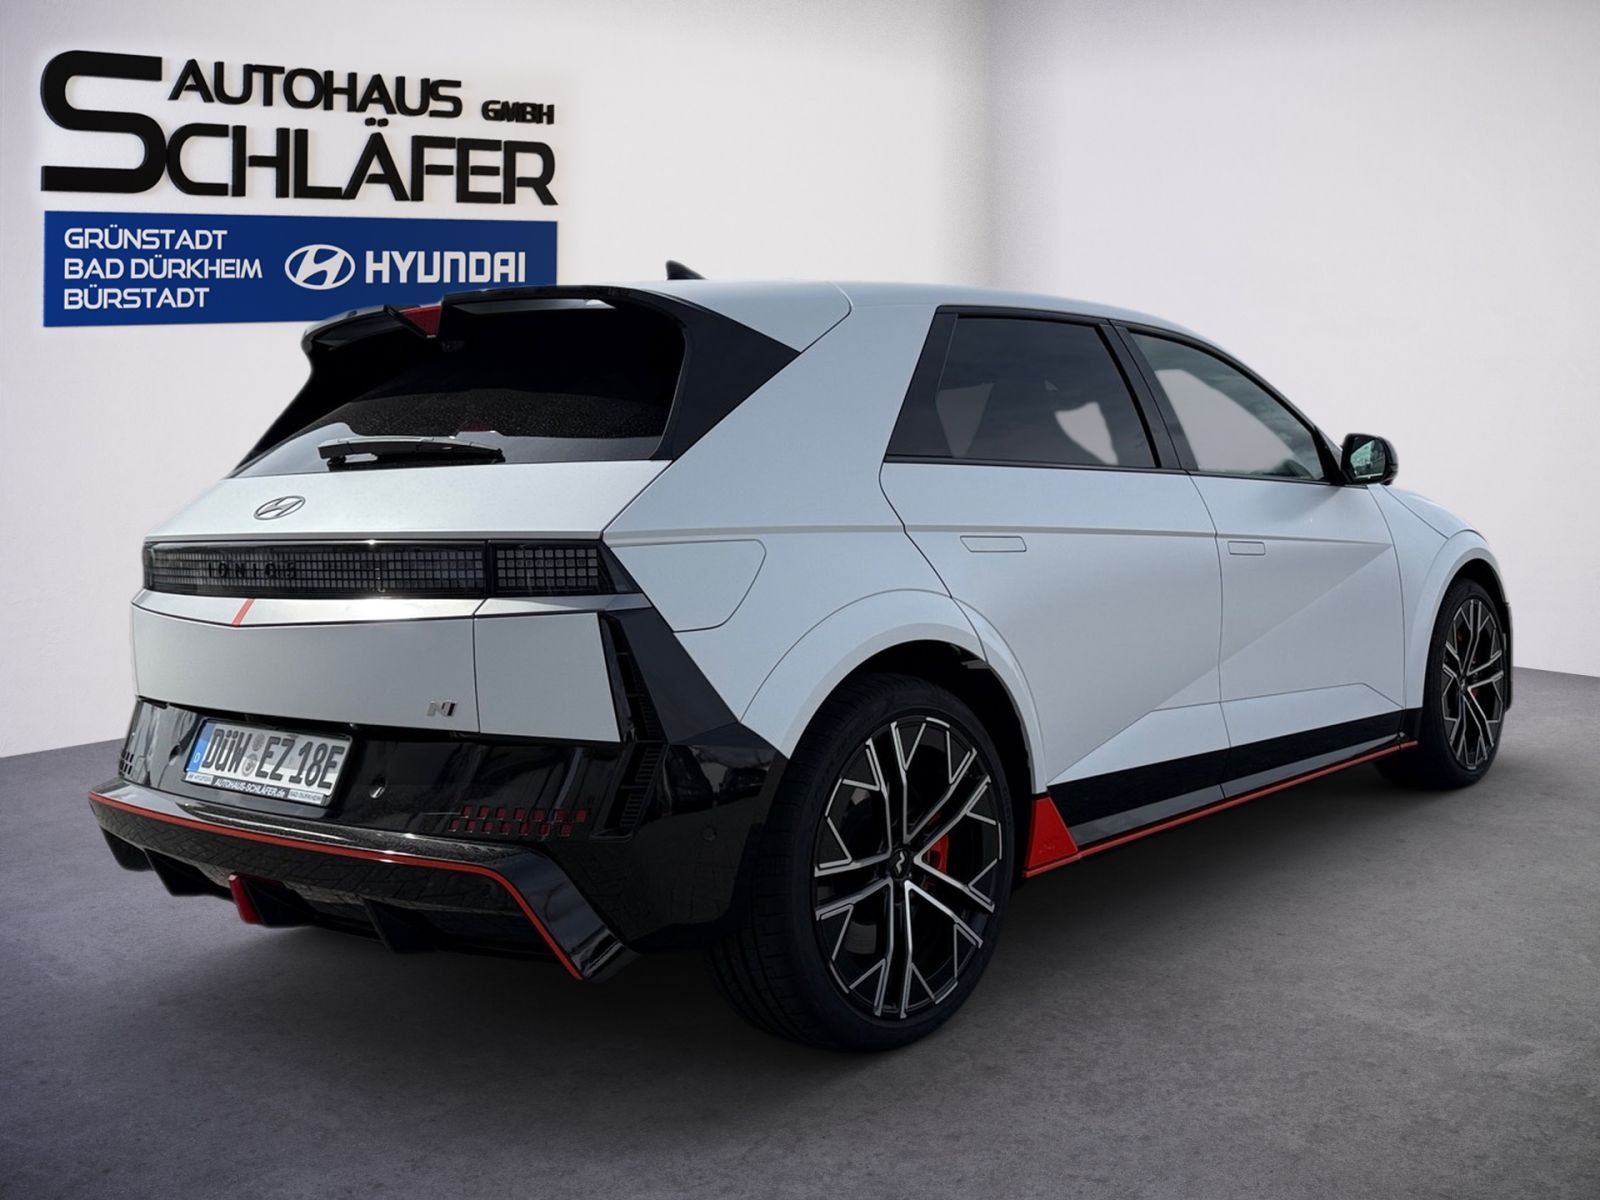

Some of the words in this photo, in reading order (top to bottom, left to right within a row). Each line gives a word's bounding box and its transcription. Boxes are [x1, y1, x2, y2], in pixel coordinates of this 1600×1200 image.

[168, 58, 463, 118] AUTOHAUS
[40, 50, 558, 205] SCHLÄFER
[64, 224, 228, 250] GRÜNSTADT
[64, 258, 125, 279] BAD
[130, 254, 263, 279] DÜRKHEIM
[365, 250, 526, 284] HYUNDAI
[64, 284, 210, 309] BÜRSTADT
[201, 728, 252, 773] DÜW
[255, 736, 296, 781] EZ
[289, 741, 345, 789] 18E
